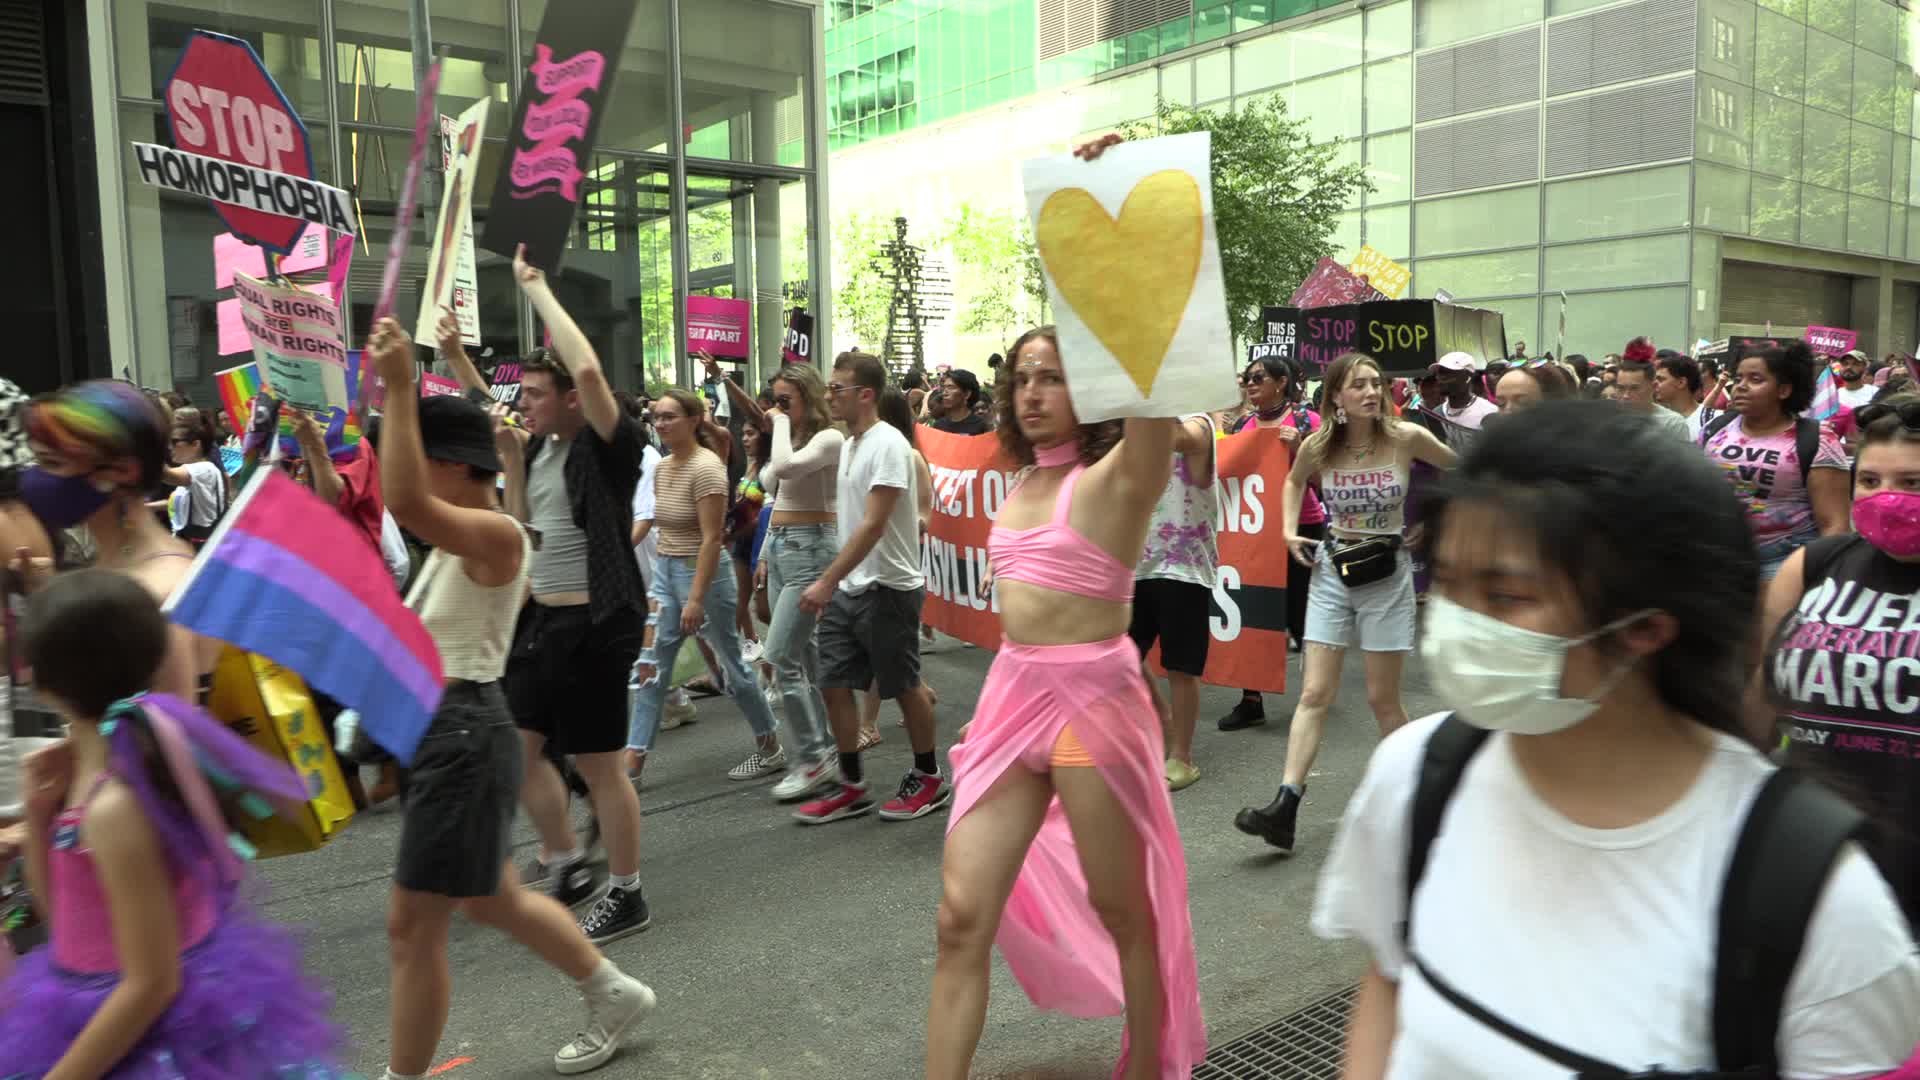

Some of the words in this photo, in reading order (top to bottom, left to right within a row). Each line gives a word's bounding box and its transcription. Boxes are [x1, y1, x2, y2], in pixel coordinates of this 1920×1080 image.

[171, 79, 295, 173] STOP
[136, 145, 352, 232] HOMOPHOBIA
[264, 315, 289, 331] are
[272, 299, 337, 327] RIGHTS
[706, 329, 742, 344] APART
[1267, 322, 1285, 335] THIS
[1287, 323, 1296, 336] IS
[1307, 317, 1356, 343] STOP
[1368, 320, 1429, 352] STOP
[283, 334, 345, 363] RIGHTS
[1253, 344, 1288, 360] DRAG
[1810, 336, 1846, 349] TRANS
[490, 383, 521, 403] POWER
[1333, 470, 1394, 489] trans
[1774, 648, 1920, 714] MARC
